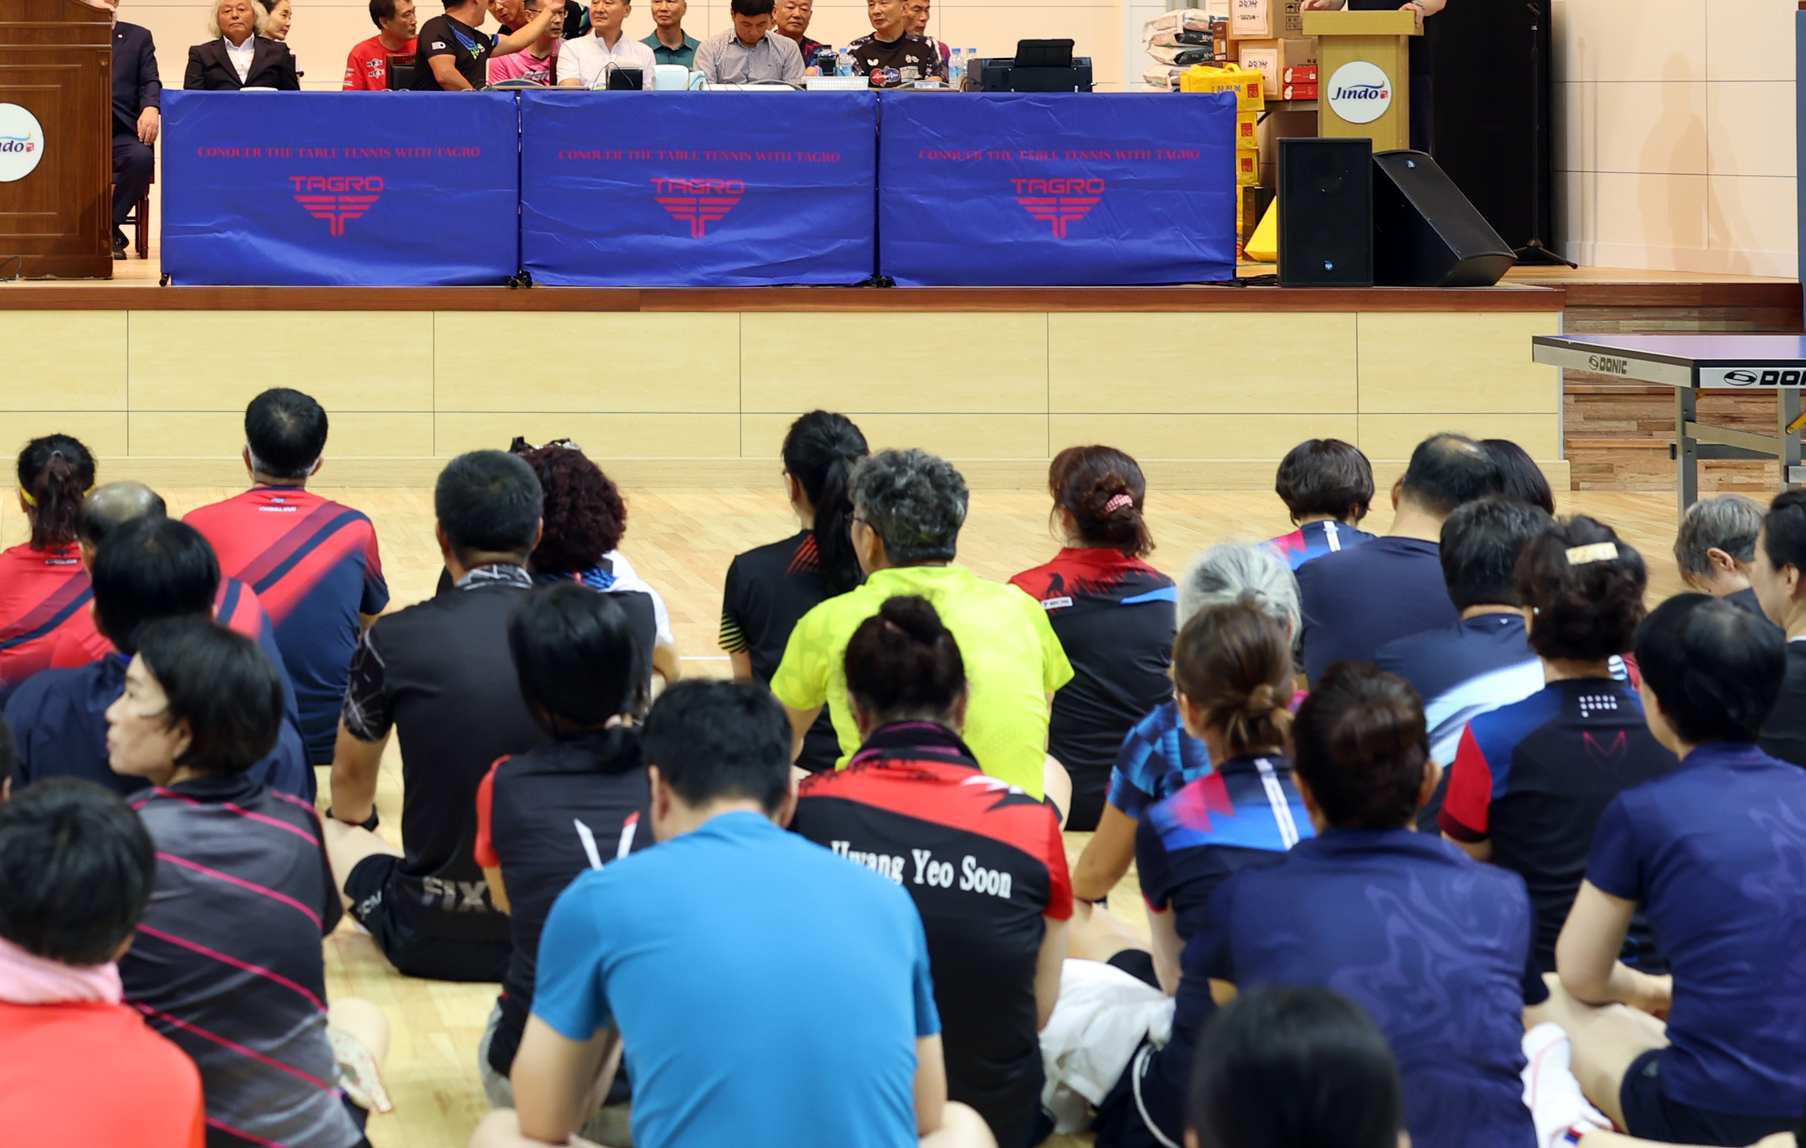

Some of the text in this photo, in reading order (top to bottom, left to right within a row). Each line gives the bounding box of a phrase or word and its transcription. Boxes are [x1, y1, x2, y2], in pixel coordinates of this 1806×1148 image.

[1331, 86, 1379, 101] Jindo
[197, 147, 482, 159] CONQUER THE TABLE TENNIS WITH TAGRO
[558, 150, 842, 163] CONQUER THE TABLE TENNIS WITH TAGRO
[918, 149, 1202, 161] CONQUER THE TABLE TENNIS WITH TAGRO
[289, 176, 385, 192] TAGRO
[650, 178, 746, 195] TAGRO
[1010, 178, 1106, 194] TAGRO
[1599, 356, 1628, 375] DONIC
[911, 848, 954, 889] Yeo
[959, 854, 1012, 899] Soon
